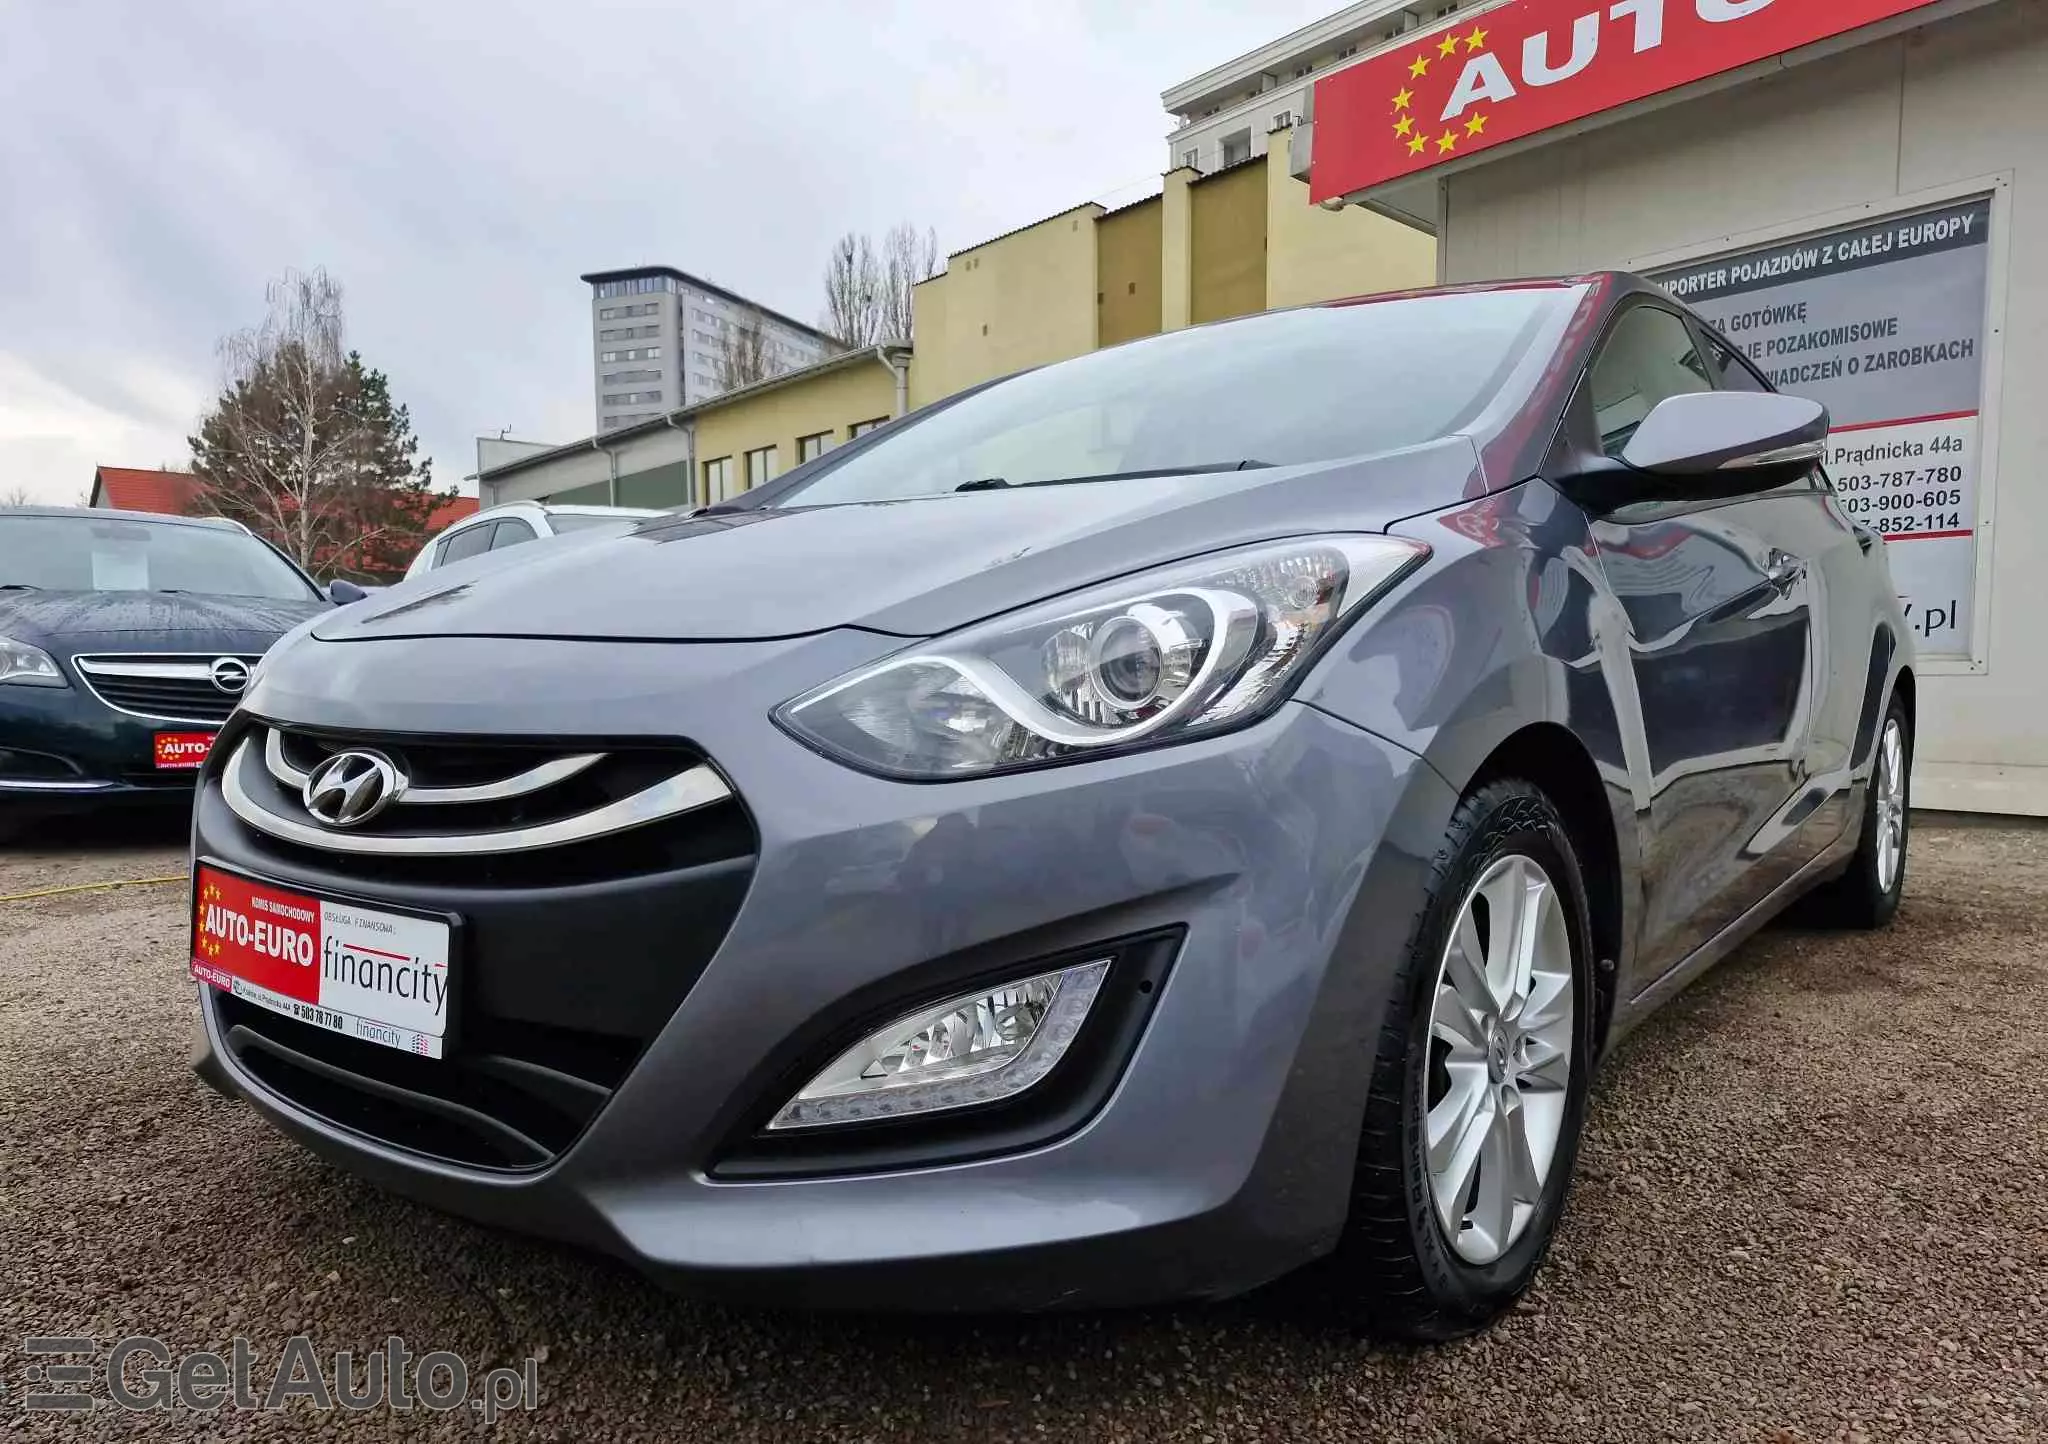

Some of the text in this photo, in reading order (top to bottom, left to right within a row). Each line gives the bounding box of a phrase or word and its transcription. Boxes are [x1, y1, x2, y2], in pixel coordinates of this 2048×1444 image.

[1731, 250, 1818, 285] POJAZDÓW
[1822, 246, 1833, 264] Z
[1838, 232, 1892, 261] CAŁEJ
[1898, 214, 1975, 248] EUROPY
[1731, 302, 1808, 332] GOTÓWKĘ
[1766, 317, 1898, 358] POZAKOMISOWE
[1848, 357, 1859, 375] O
[1864, 338, 1974, 373] ZAROBKACH
[1930, 435, 1963, 454] 44a
[1838, 466, 1961, 492] 503-787-780
[1840, 490, 1961, 513] 03-900-605
[269, 902, 315, 923] SAMOCHODOWY
[205, 903, 314, 967] AUTO-EURO
[194, 964, 231, 988] AUTO-EURO
[324, 935, 448, 1016] financity
[302, 1005, 314, 1021] 503
[316, 1009, 323, 1024] 78
[325, 1012, 332, 1027] 77
[334, 1014, 343, 1030] 80
[357, 1016, 401, 1048] financity
